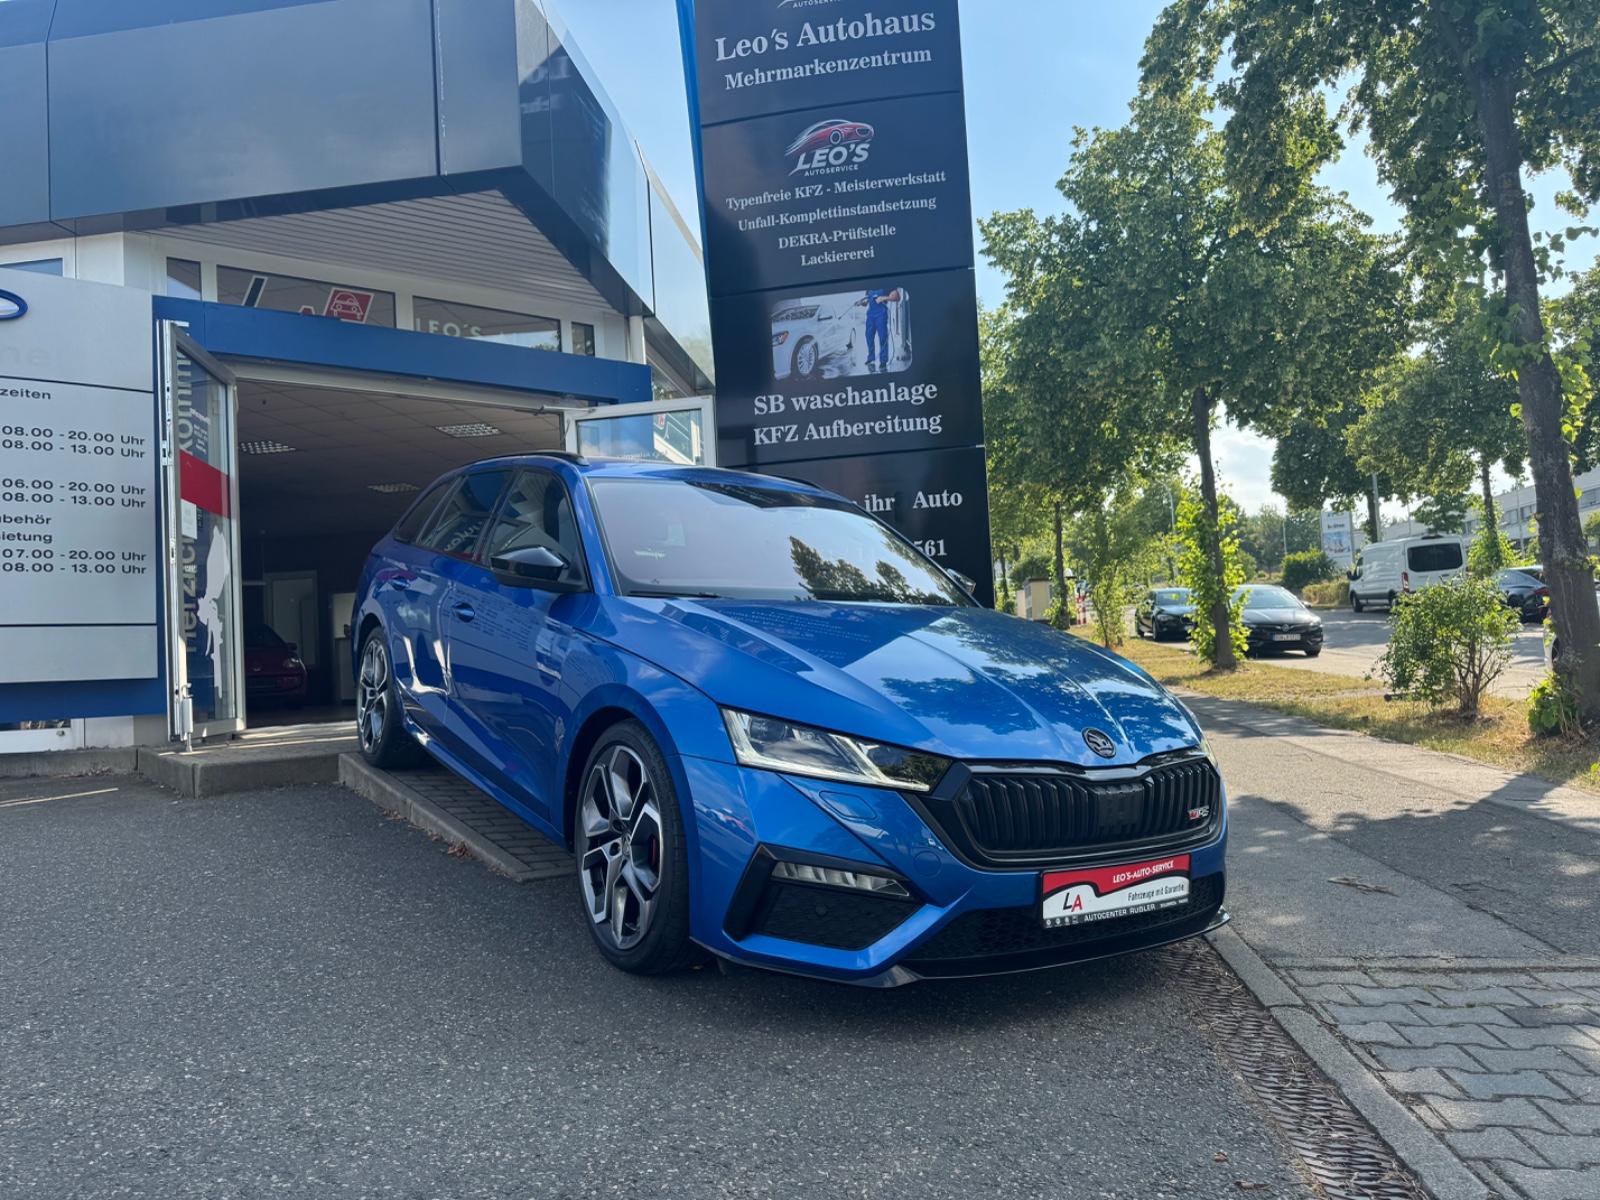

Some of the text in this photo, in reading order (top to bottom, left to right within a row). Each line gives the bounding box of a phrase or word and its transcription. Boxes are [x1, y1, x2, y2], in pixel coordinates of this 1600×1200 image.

[797, 12, 936, 46] Autohaus
[725, 50, 932, 90] Mehrmarkenzentrum
[796, 144, 871, 170] LEO'S
[804, 164, 859, 177] AUTOSERVICE
[726, 189, 792, 211] Typenfreie
[795, 184, 824, 199] KFZ
[834, 170, 947, 194] Meisterwerkstatt
[738, 197, 937, 232] Unfall-Komplettinstandsetzung
[778, 224, 897, 249] DEKRA-Prüfstelle
[801, 246, 875, 267] Lackiererei
[754, 382, 938, 415] SB waschanlage
[1, 425, 54, 438] 08.00
[67, 430, 115, 443] 20.00
[120, 435, 146, 446] Uhr
[754, 414, 943, 446] KFZ Aufbereitung
[1, 439, 54, 452] 08.00
[70, 444, 115, 456] 13.00
[120, 448, 146, 459] Uhr
[1, 478, 54, 490] 06.00
[68, 481, 115, 494] 20.00
[121, 485, 147, 496] Uhr
[1, 491, 54, 504] 08.00
[70, 495, 116, 507] 13.00
[121, 498, 147, 509] Uhr
[864, 490, 963, 512] ihr Auto
[0, 514, 52, 525] behör
[0, 531, 53, 544] ietung
[1, 548, 54, 560] 07.00
[68, 550, 116, 561] 20.00
[121, 552, 147, 562] Uhr
[1, 562, 54, 574] 08.00
[71, 564, 116, 575] 13.00
[121, 565, 147, 575] Uhr
[1112, 860, 1175, 883] LEO'S-AUTO-SERVICE
[1063, 892, 1083, 912] LA
[1083, 909, 1128, 922] AUTOCENTER
